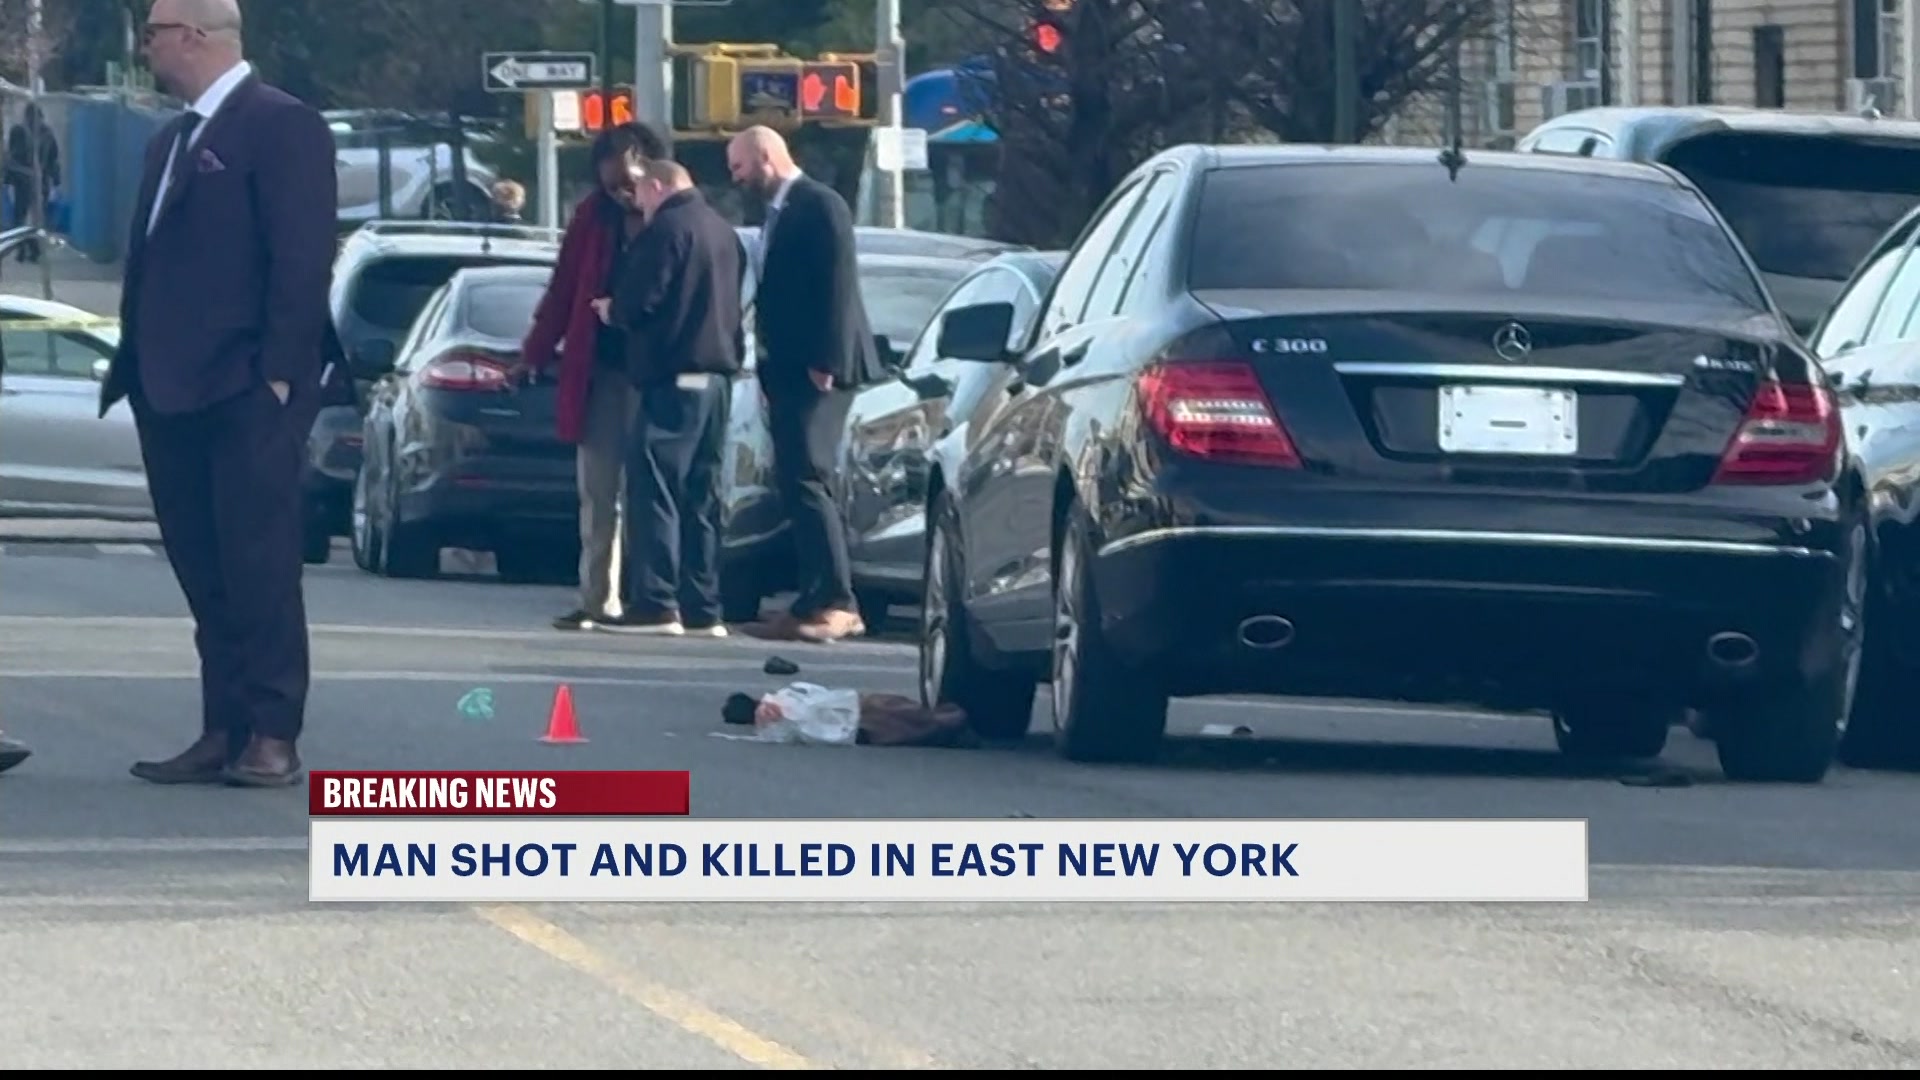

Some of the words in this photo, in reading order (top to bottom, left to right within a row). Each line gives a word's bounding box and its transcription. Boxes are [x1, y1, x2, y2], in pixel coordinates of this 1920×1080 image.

[501, 63, 528, 80] ONE
[546, 64, 578, 79] WAY
[1252, 338, 1268, 353] C
[1275, 338, 1328, 353] 300
